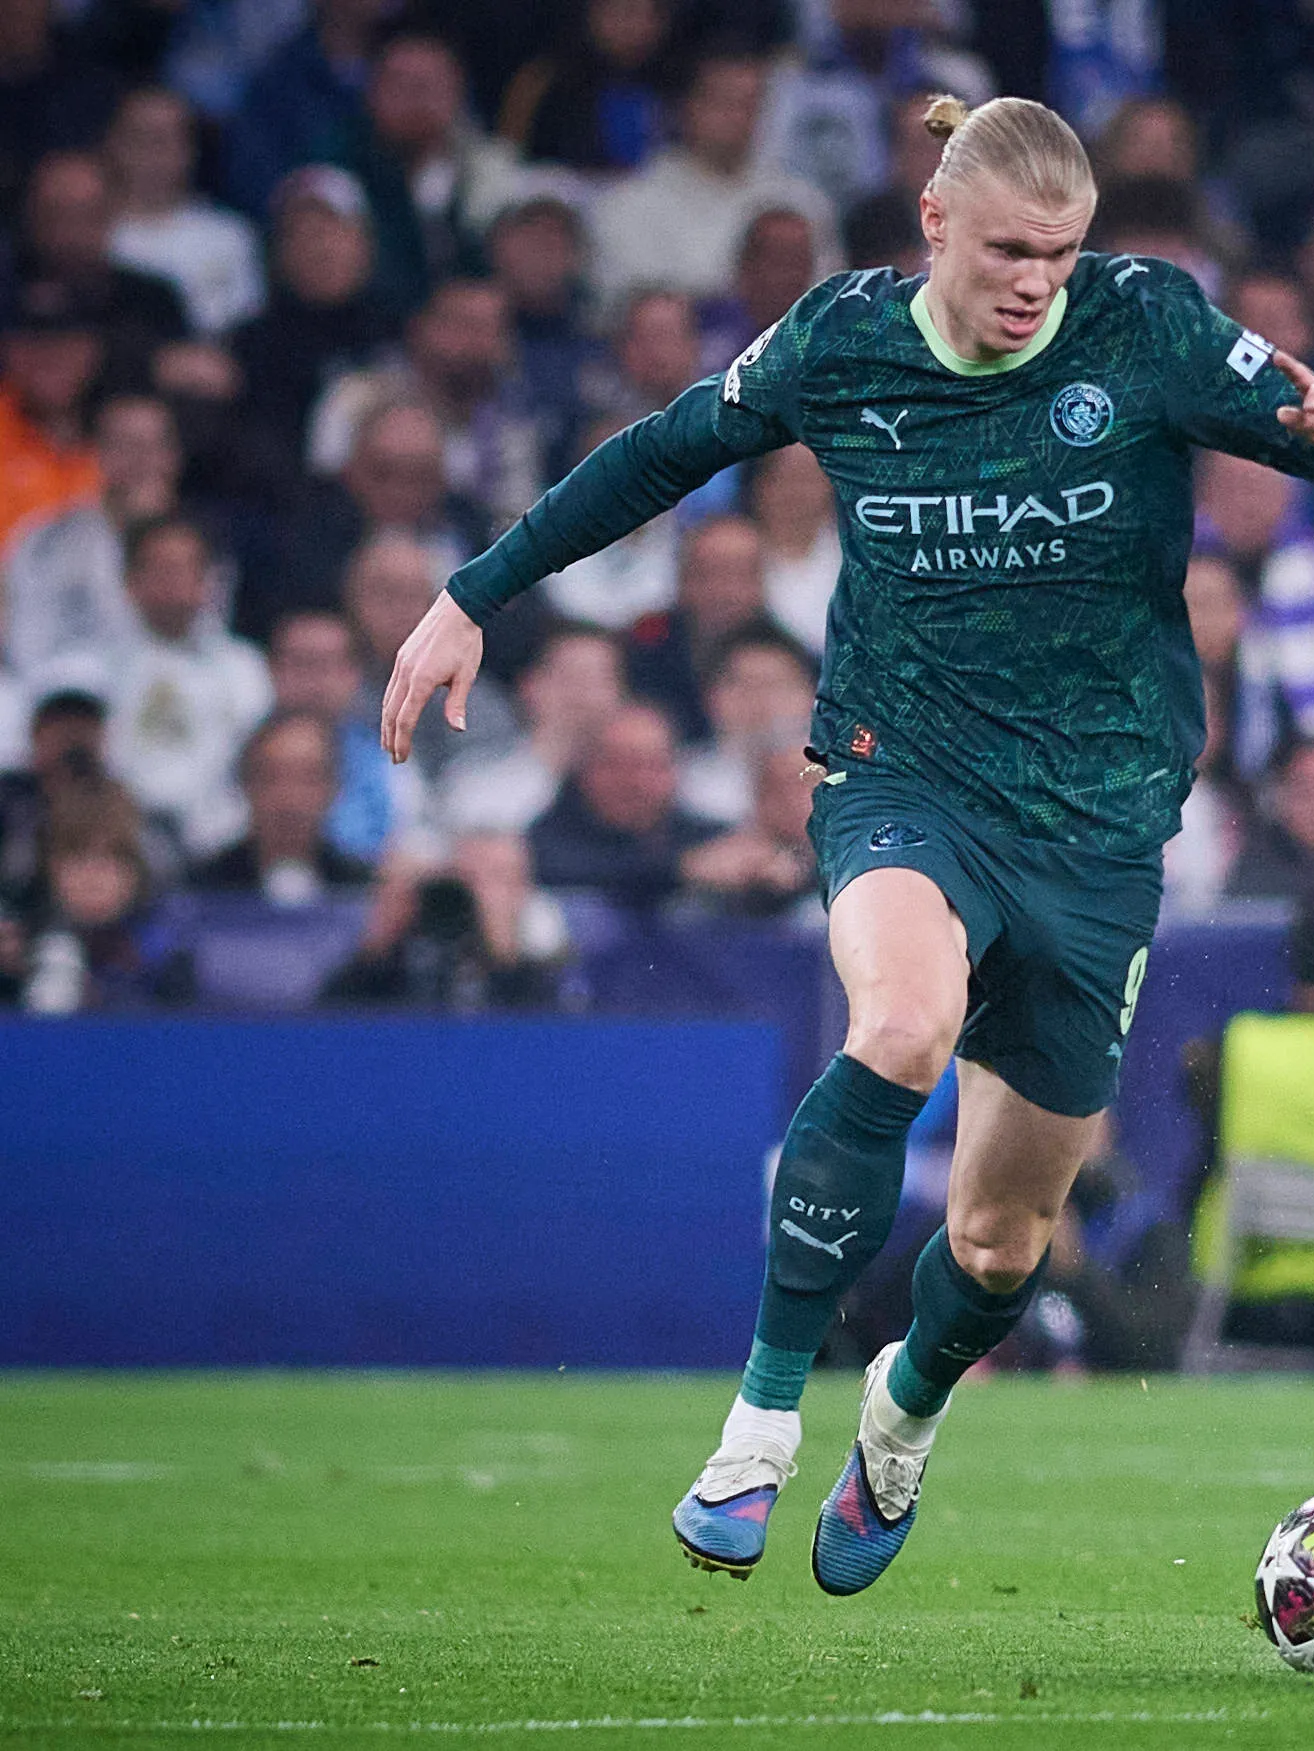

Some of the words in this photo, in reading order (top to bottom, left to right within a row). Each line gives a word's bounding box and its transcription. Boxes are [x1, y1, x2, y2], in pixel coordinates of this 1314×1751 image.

[855, 481, 1114, 534] ETIHAD
[911, 539, 1066, 572] AIRWAYS
[1120, 946, 1149, 1036] 9
[789, 1196, 860, 1221] CITY
